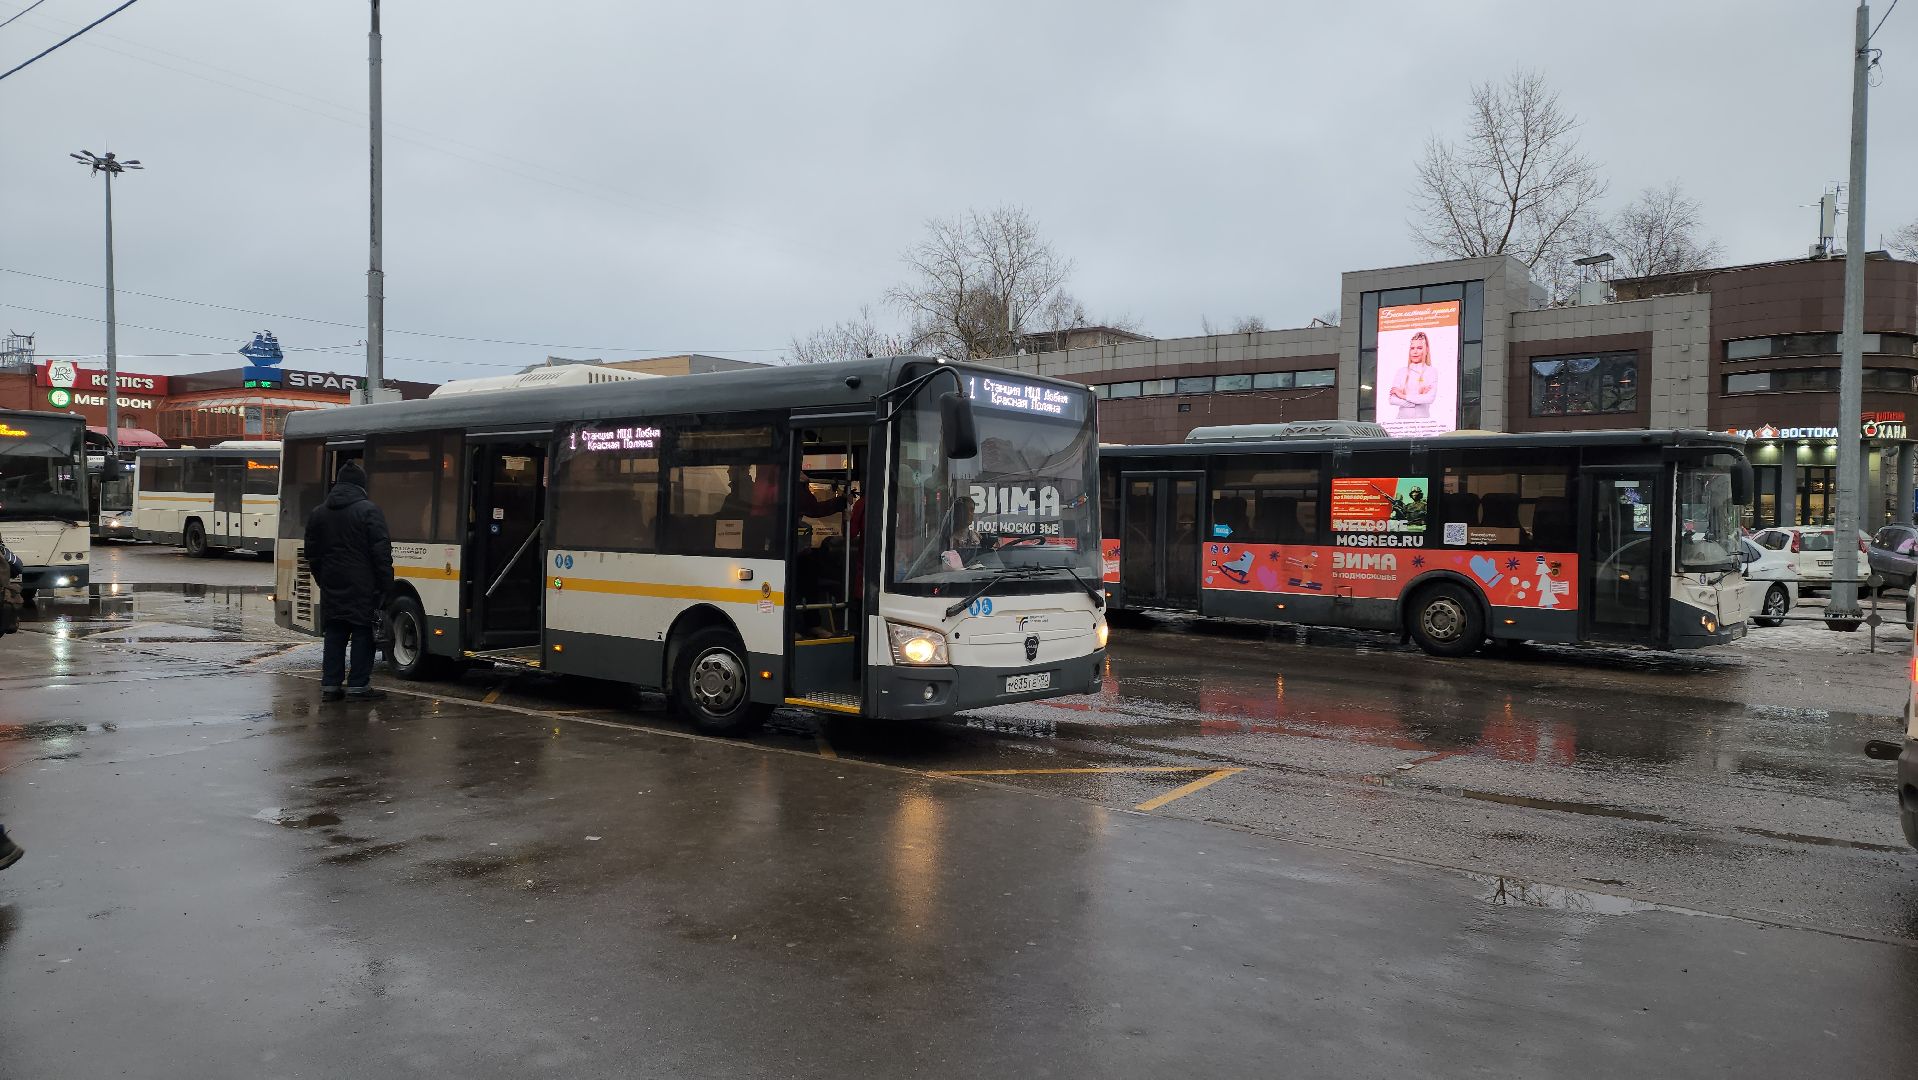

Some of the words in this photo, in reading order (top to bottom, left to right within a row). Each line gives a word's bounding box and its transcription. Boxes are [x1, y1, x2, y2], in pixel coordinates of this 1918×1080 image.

[289, 373, 357, 390] SPAR
[970, 377, 976, 399] 1
[984, 379, 1021, 396] Станция
[1025, 386, 1041, 400] МЦД
[74, 393, 153, 409] МЕГФОН
[992, 392, 1028, 409] Красная
[1031, 400, 1061, 413] Поляна
[569, 432, 576, 450] 1
[581, 430, 614, 441] Станция
[617, 428, 632, 439] МЦД
[635, 427, 661, 439] Лобня
[1781, 427, 1839, 439] ВОСТОКА
[587, 440, 620, 451] Красная
[623, 439, 653, 449] Поляна
[969, 485, 1060, 516] ЗИМА
[1337, 535, 1424, 547] MOSREG.RU
[1333, 552, 1396, 570] ЗИМА
[1339, 572, 1397, 581] ПОДМОСКОВЬЕ
